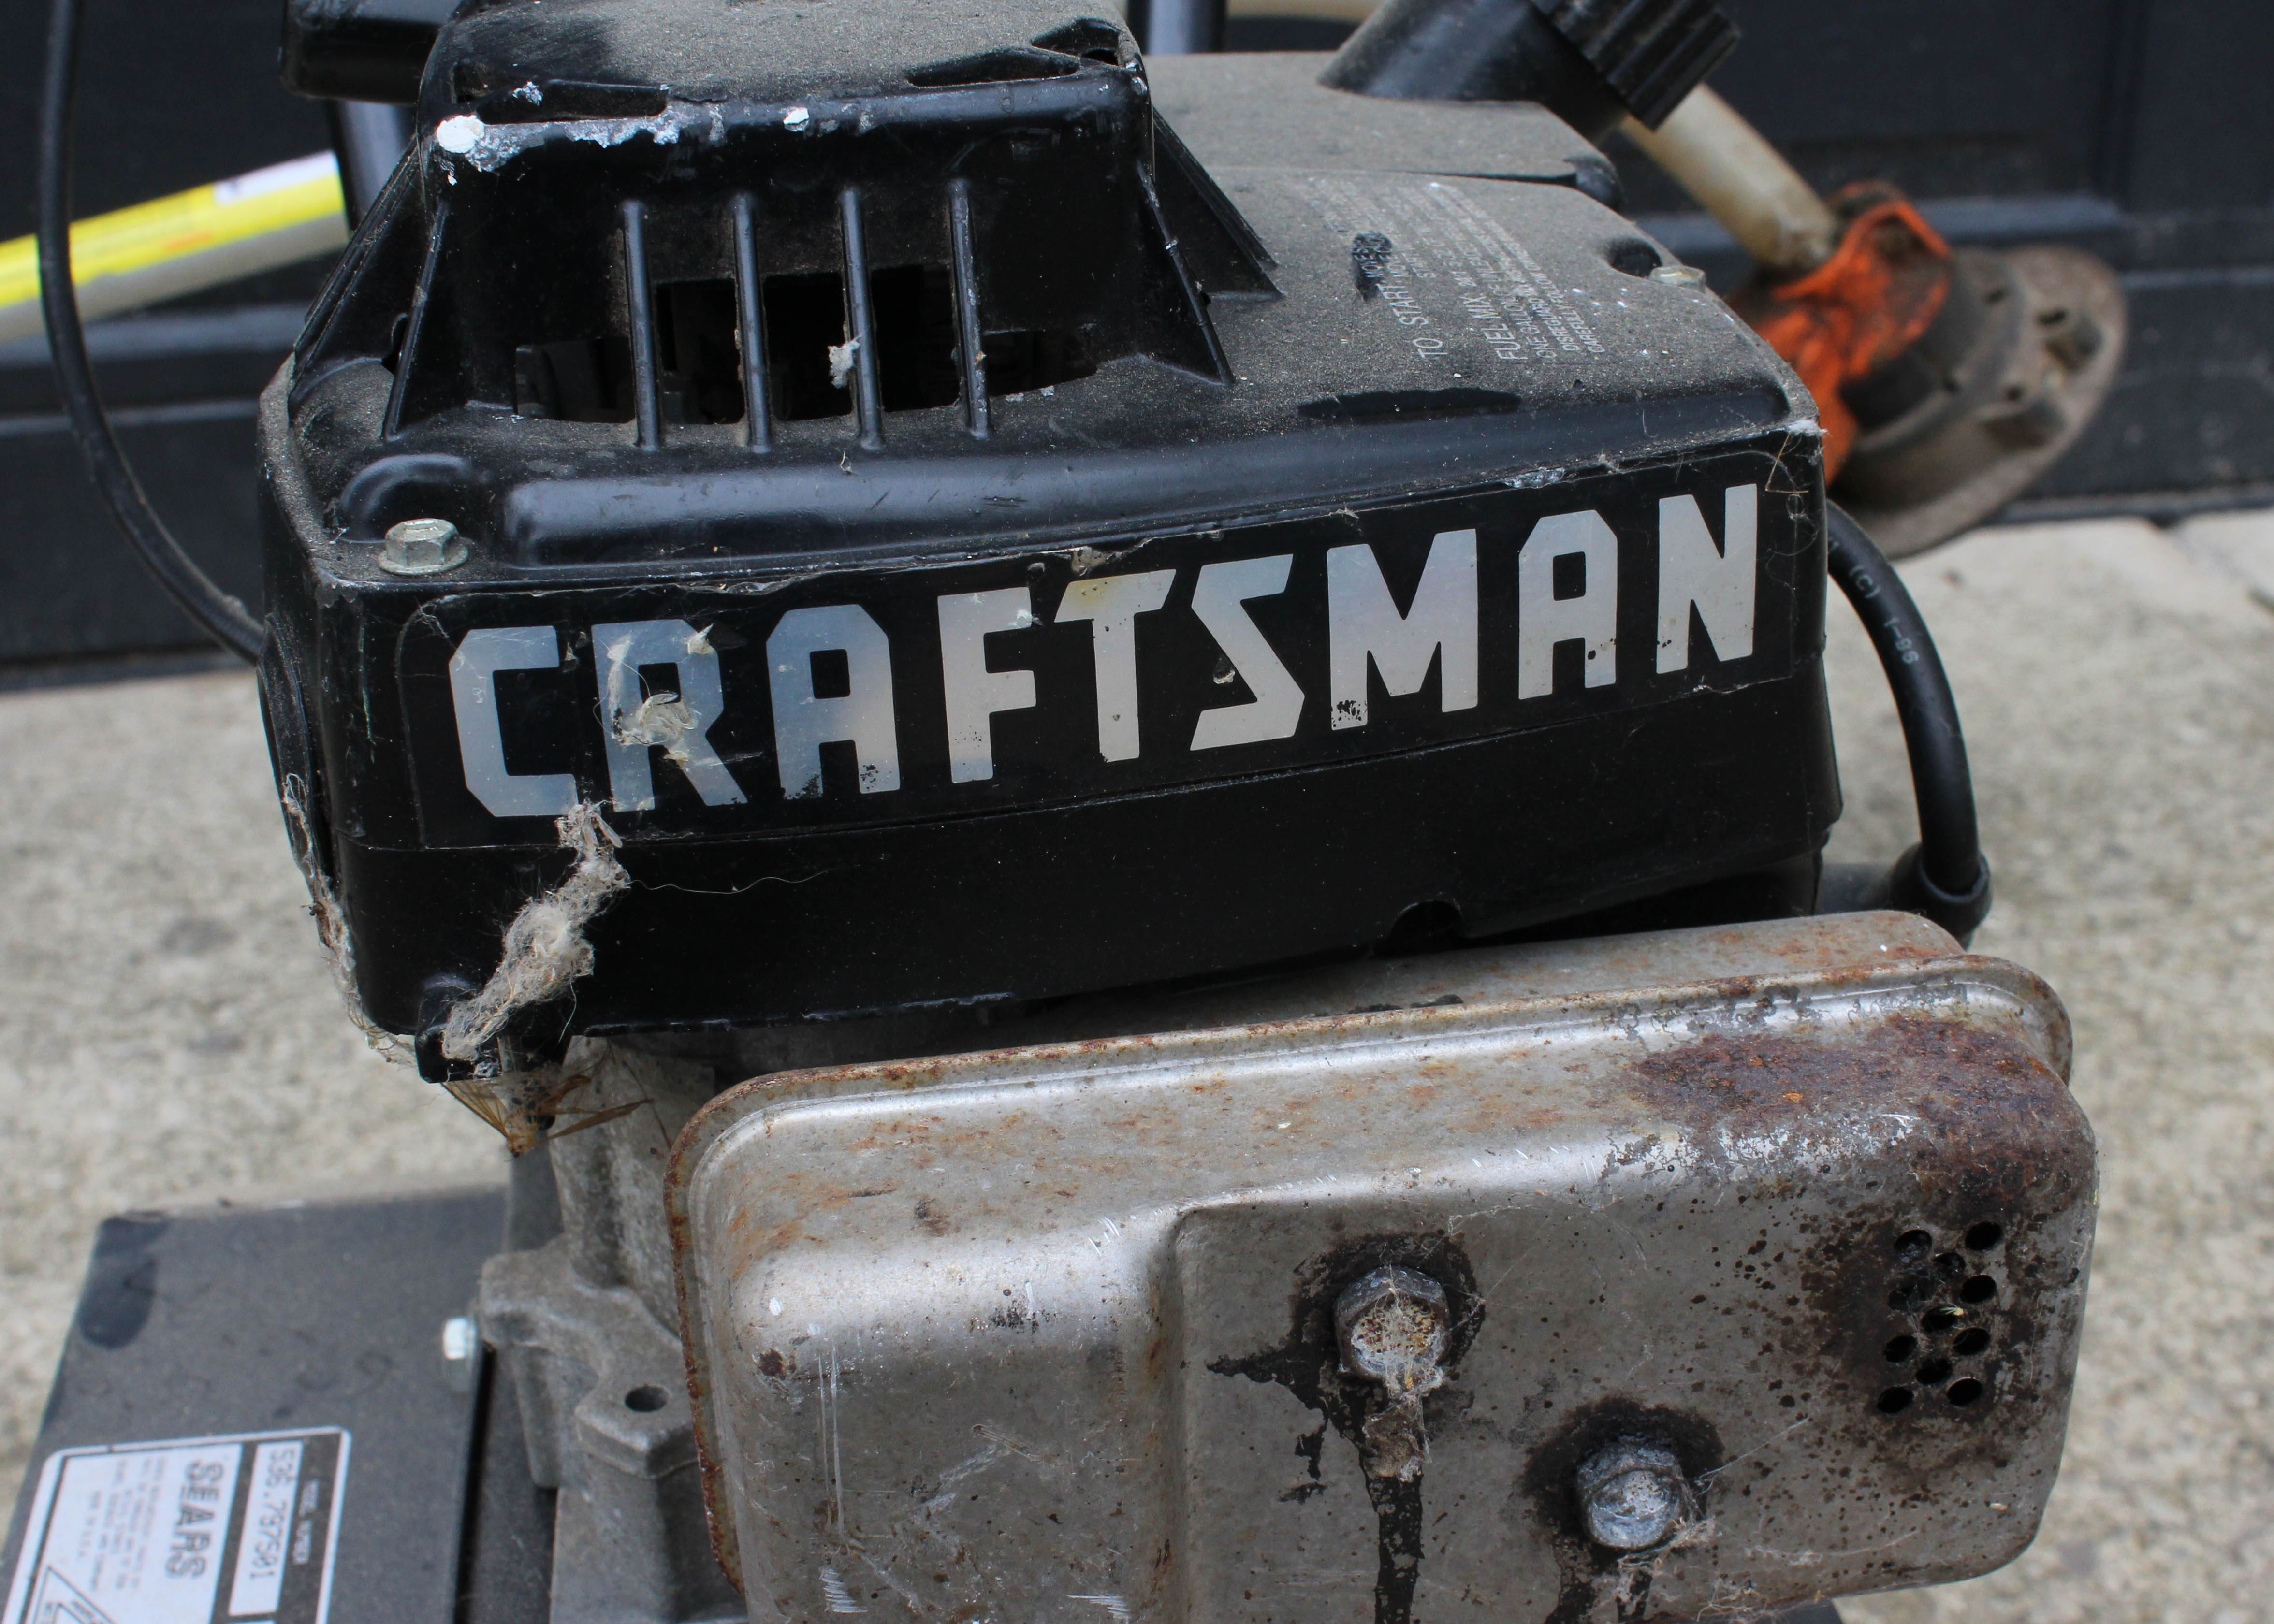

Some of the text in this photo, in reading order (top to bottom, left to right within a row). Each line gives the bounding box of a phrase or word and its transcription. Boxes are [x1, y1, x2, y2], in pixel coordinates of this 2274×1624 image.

[1413, 338, 1453, 358] TO
[1480, 323, 1528, 360] FUEL
[1525, 336, 1557, 358] ONE
[1553, 304, 1605, 353] CAREFULLY
[449, 483, 1757, 818] CRAFTSMAN
[165, 1458, 225, 1579] SEARS
